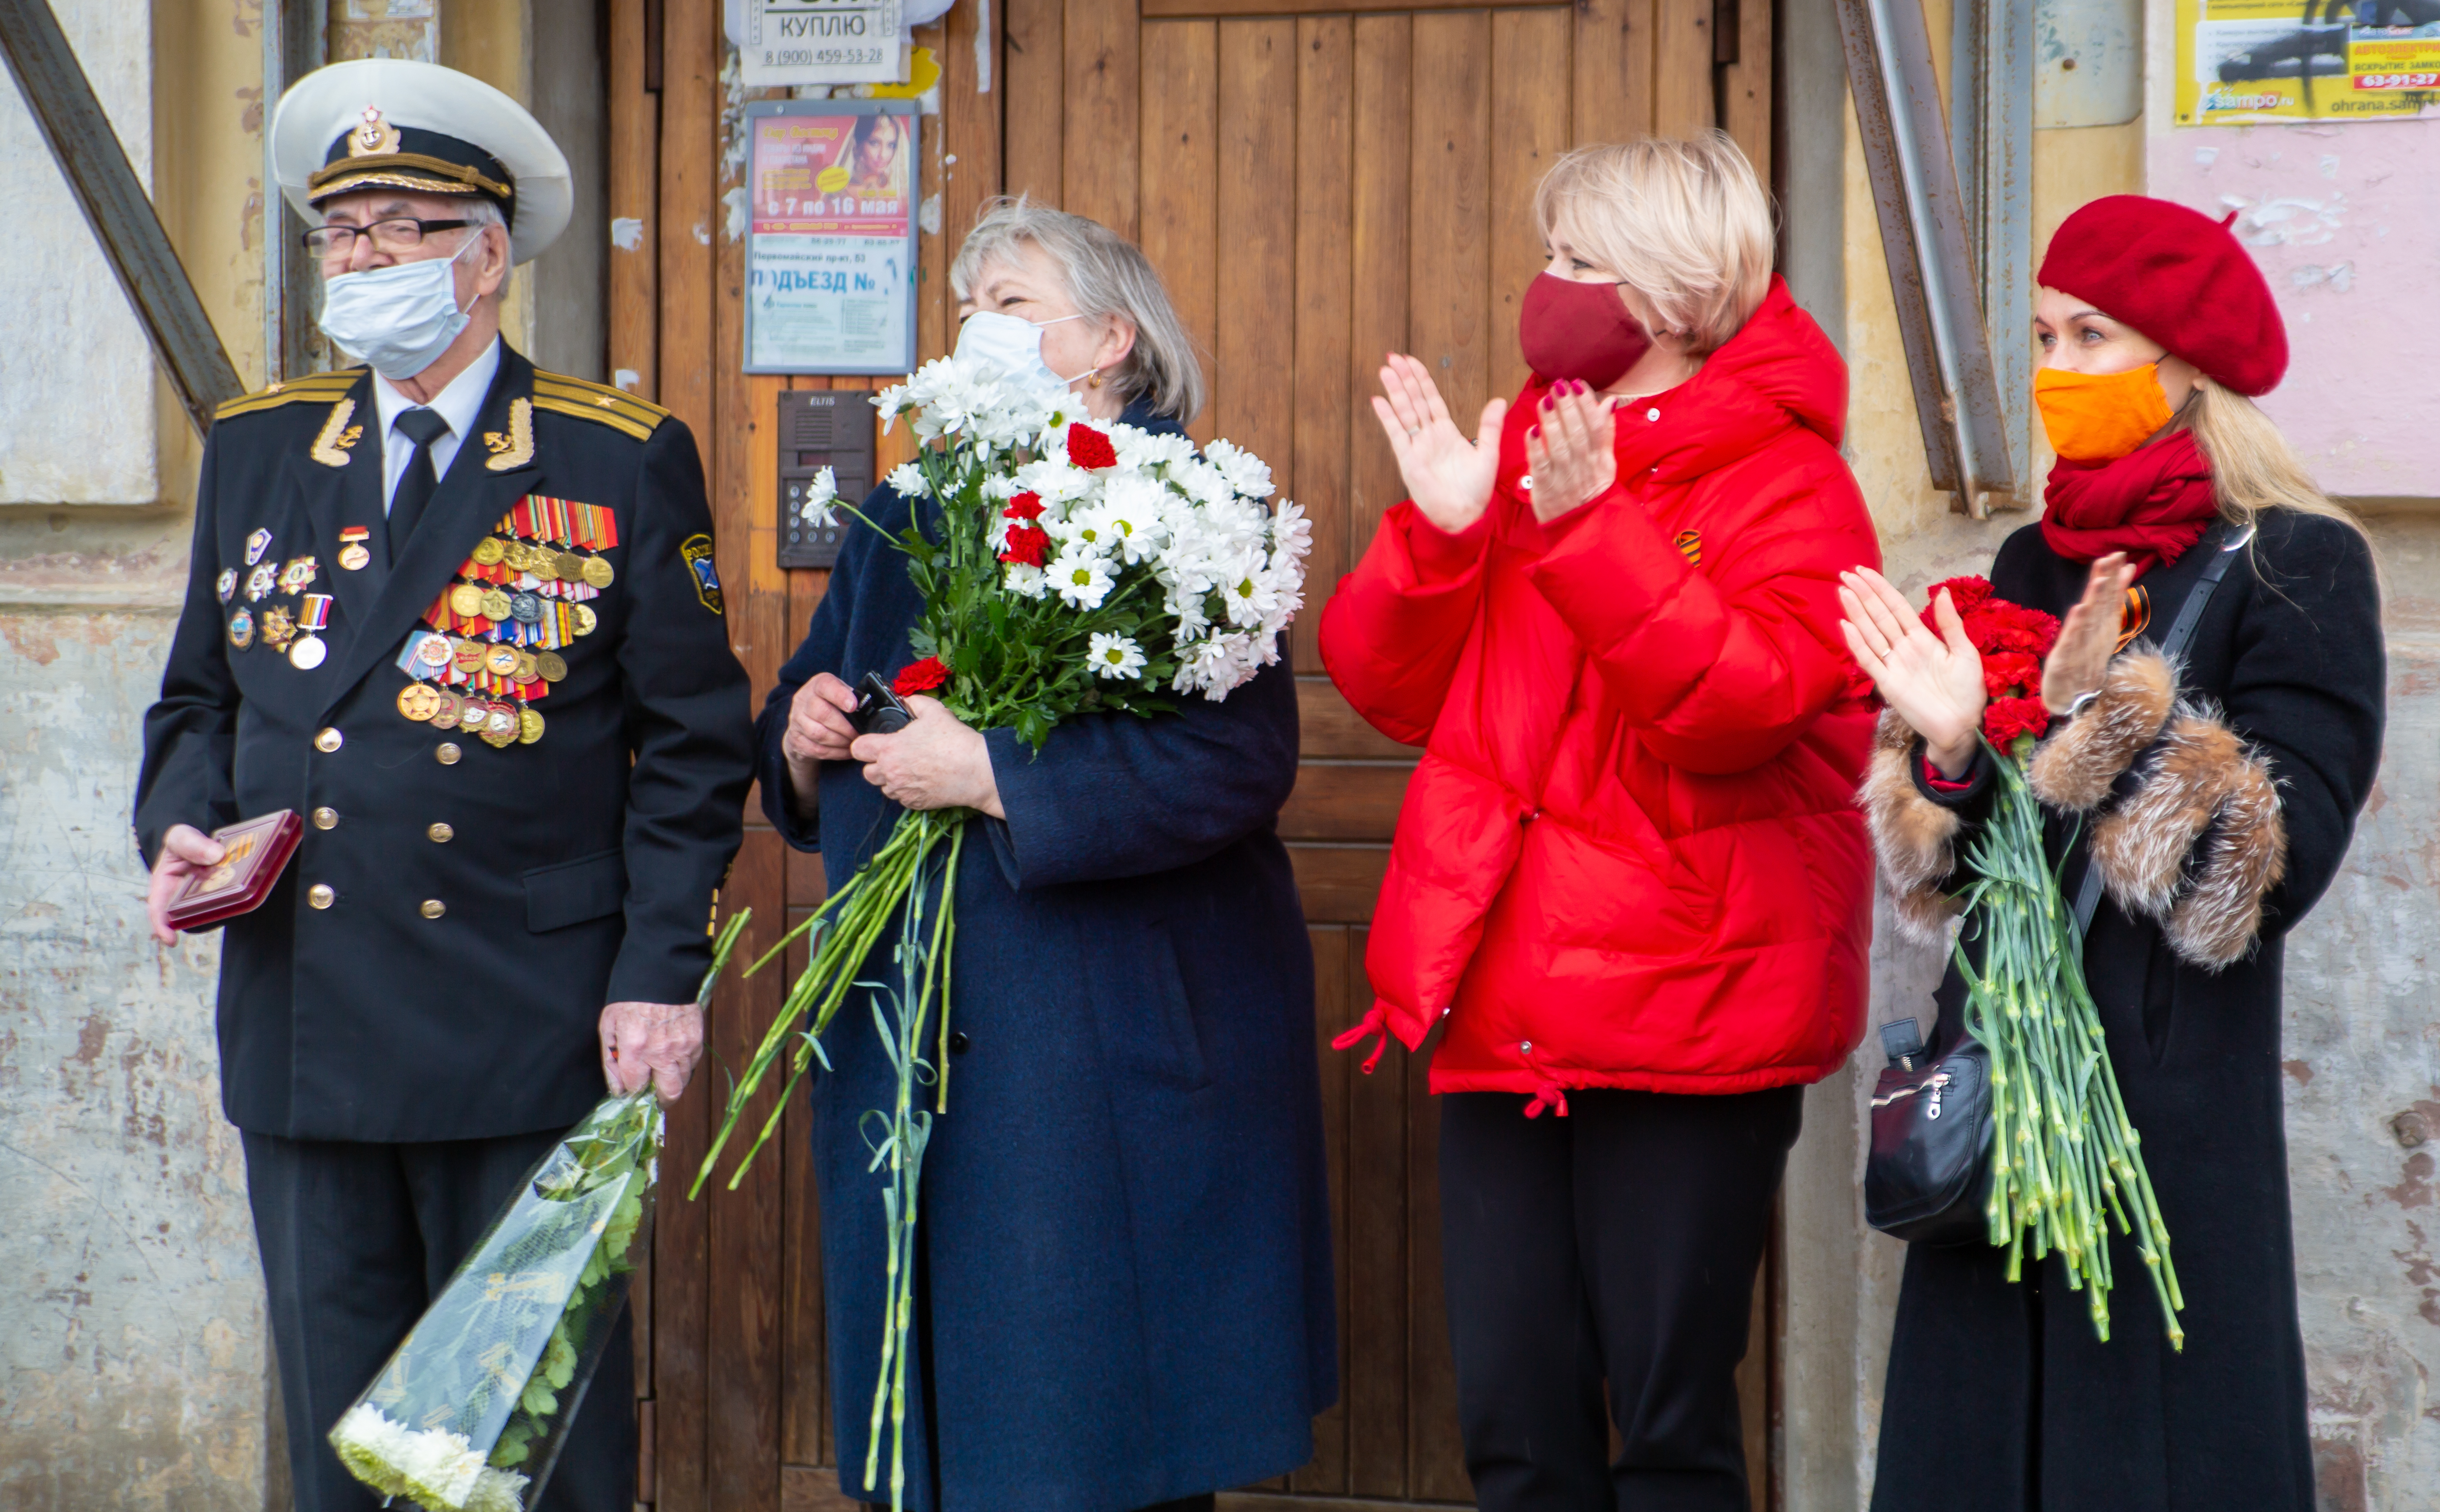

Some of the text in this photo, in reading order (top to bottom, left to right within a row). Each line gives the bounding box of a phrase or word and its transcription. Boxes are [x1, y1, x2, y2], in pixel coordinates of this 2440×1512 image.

[781, 15, 866, 38] КУПЛЮ
[765, 48, 884, 66] 8 (900) 459-53-28
[2362, 73, 2438, 87] 63-91-27
[768, 197, 898, 216] с 7 по 16 мая
[754, 251, 823, 262] Первомайский
